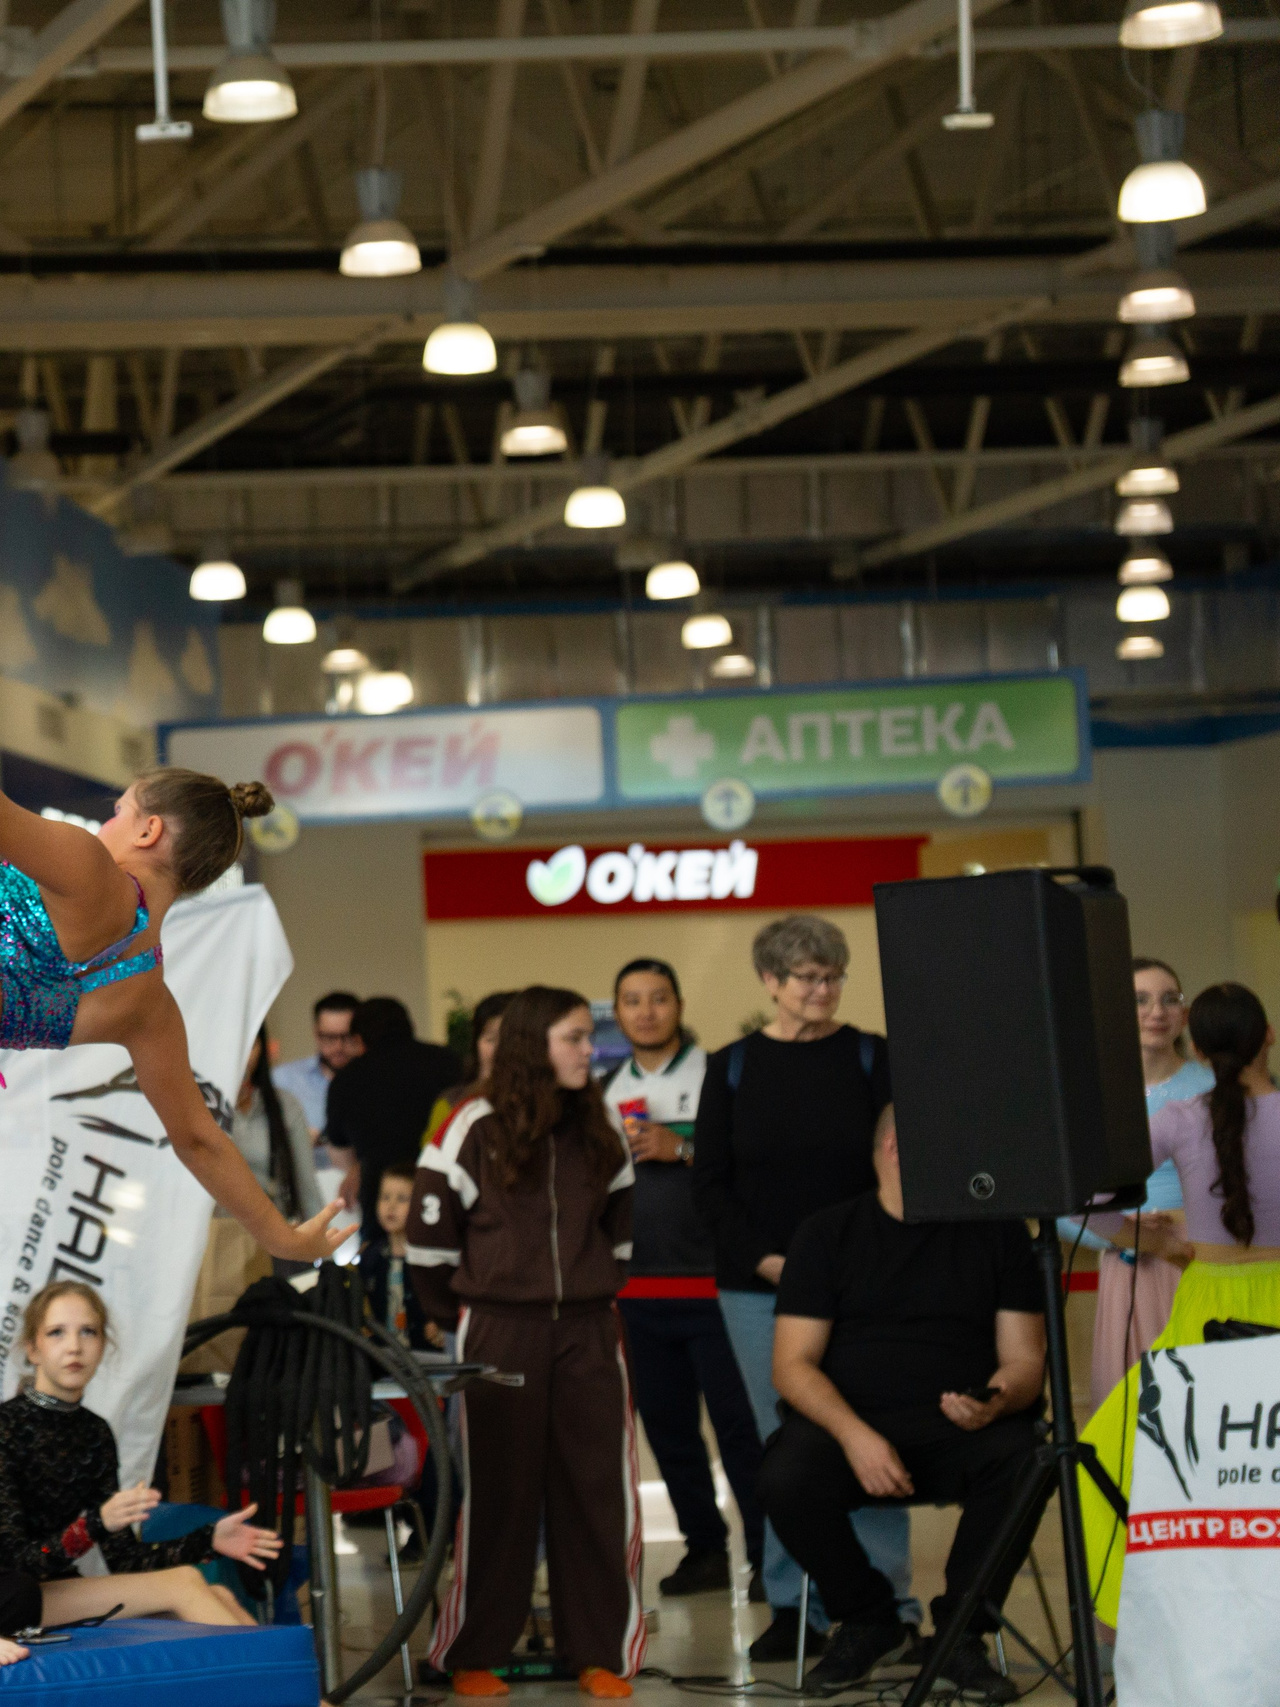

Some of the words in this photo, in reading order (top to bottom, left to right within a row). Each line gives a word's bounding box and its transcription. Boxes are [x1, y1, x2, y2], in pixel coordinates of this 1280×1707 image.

[740, 702, 1015, 765] АПТЕКА
[42, 1136, 68, 1191] pole
[46, 1154, 127, 1286] HAL
[421, 1194, 440, 1225] 3
[18, 1197, 53, 1271] dance
[12, 1277, 30, 1293] &
[1218, 1463, 1261, 1489] pole
[1129, 1517, 1225, 1546] ЦЕНТР
[1229, 1517, 1280, 1540] ВО
